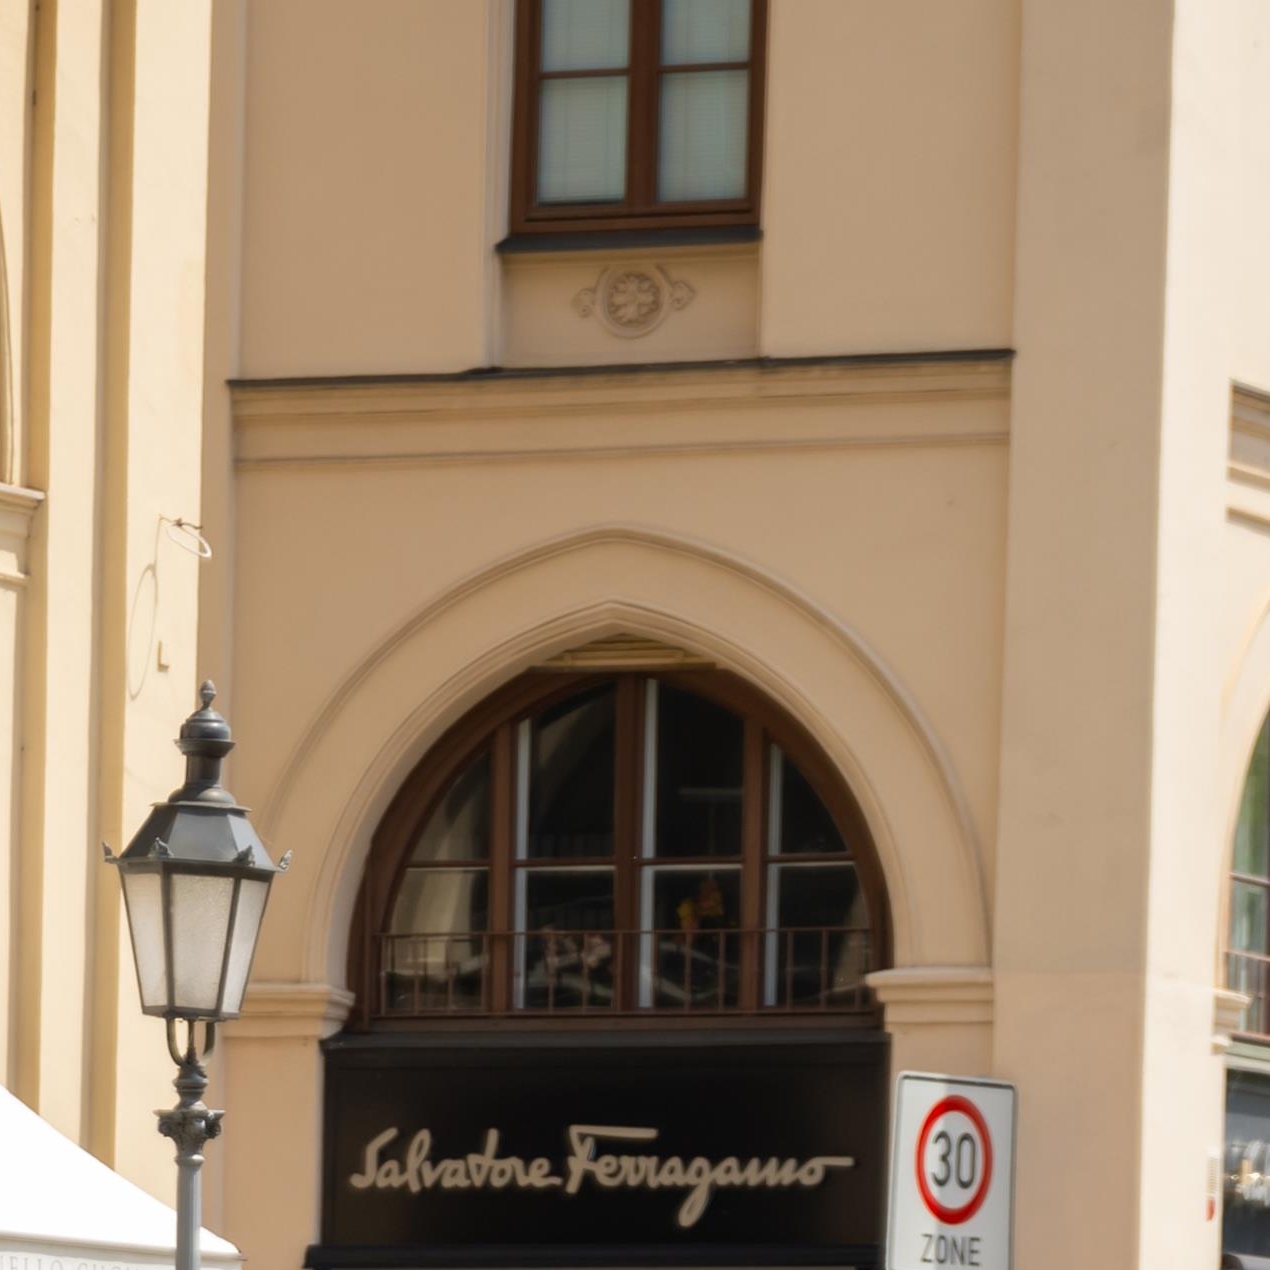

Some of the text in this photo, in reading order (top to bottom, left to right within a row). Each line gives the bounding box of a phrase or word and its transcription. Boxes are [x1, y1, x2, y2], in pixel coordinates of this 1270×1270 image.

[351, 1124, 854, 1227] Salvatore Ferragamo
[931, 1130, 976, 1189] 30
[920, 1233, 981, 1266] ZONE
